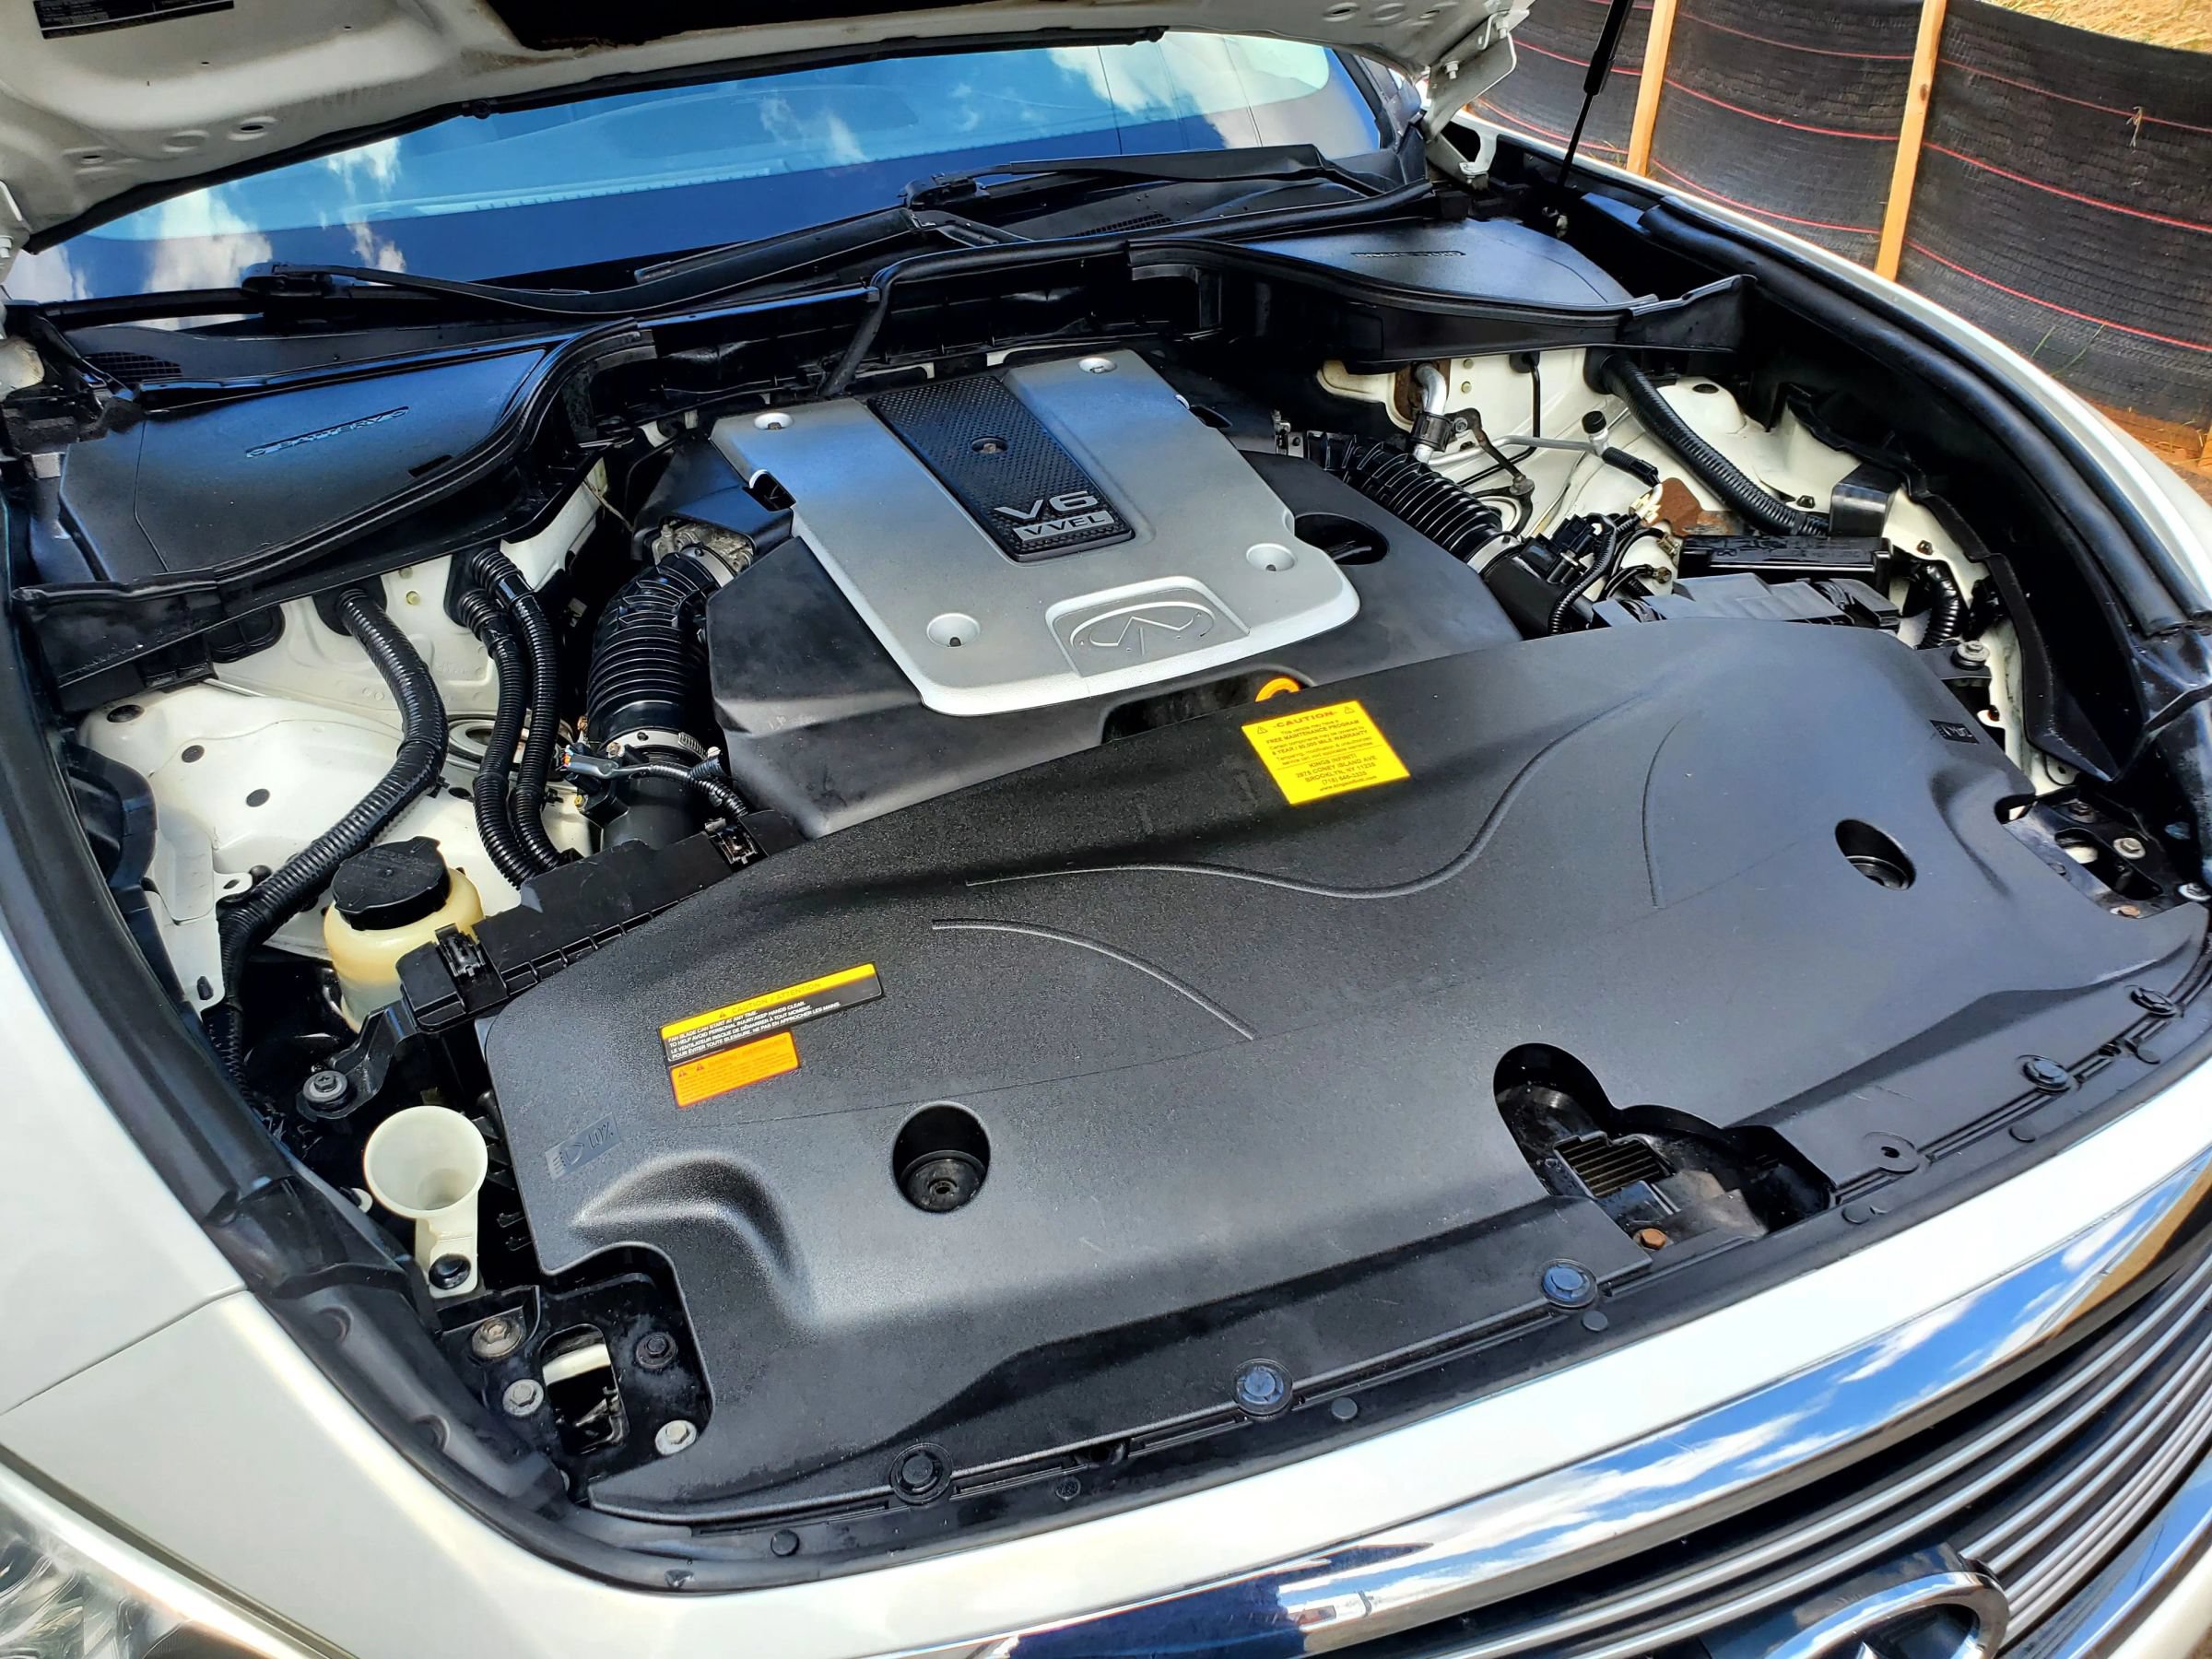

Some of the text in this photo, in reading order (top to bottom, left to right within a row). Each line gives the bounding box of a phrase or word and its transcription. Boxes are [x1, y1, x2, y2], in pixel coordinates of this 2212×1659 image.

[994, 490, 1098, 520] V6
[1024, 515, 1107, 535] VVEL
[1284, 727, 1327, 740] MAINTENANCE
[1328, 720, 1359, 729] PROGRAM
[1334, 730, 1368, 740] WARRANTY
[1309, 753, 1357, 768] KINGS INFINITI
[1312, 765, 1335, 773] CONEY
[1337, 759, 1362, 768] ISLAND
[733, 999, 767, 1013] CAUTION
[777, 982, 820, 999] ATTENTION
[680, 1030, 696, 1038] BLADE
[692, 1032, 708, 1041] AVOID
[708, 1023, 736, 1035] PERSONAL
